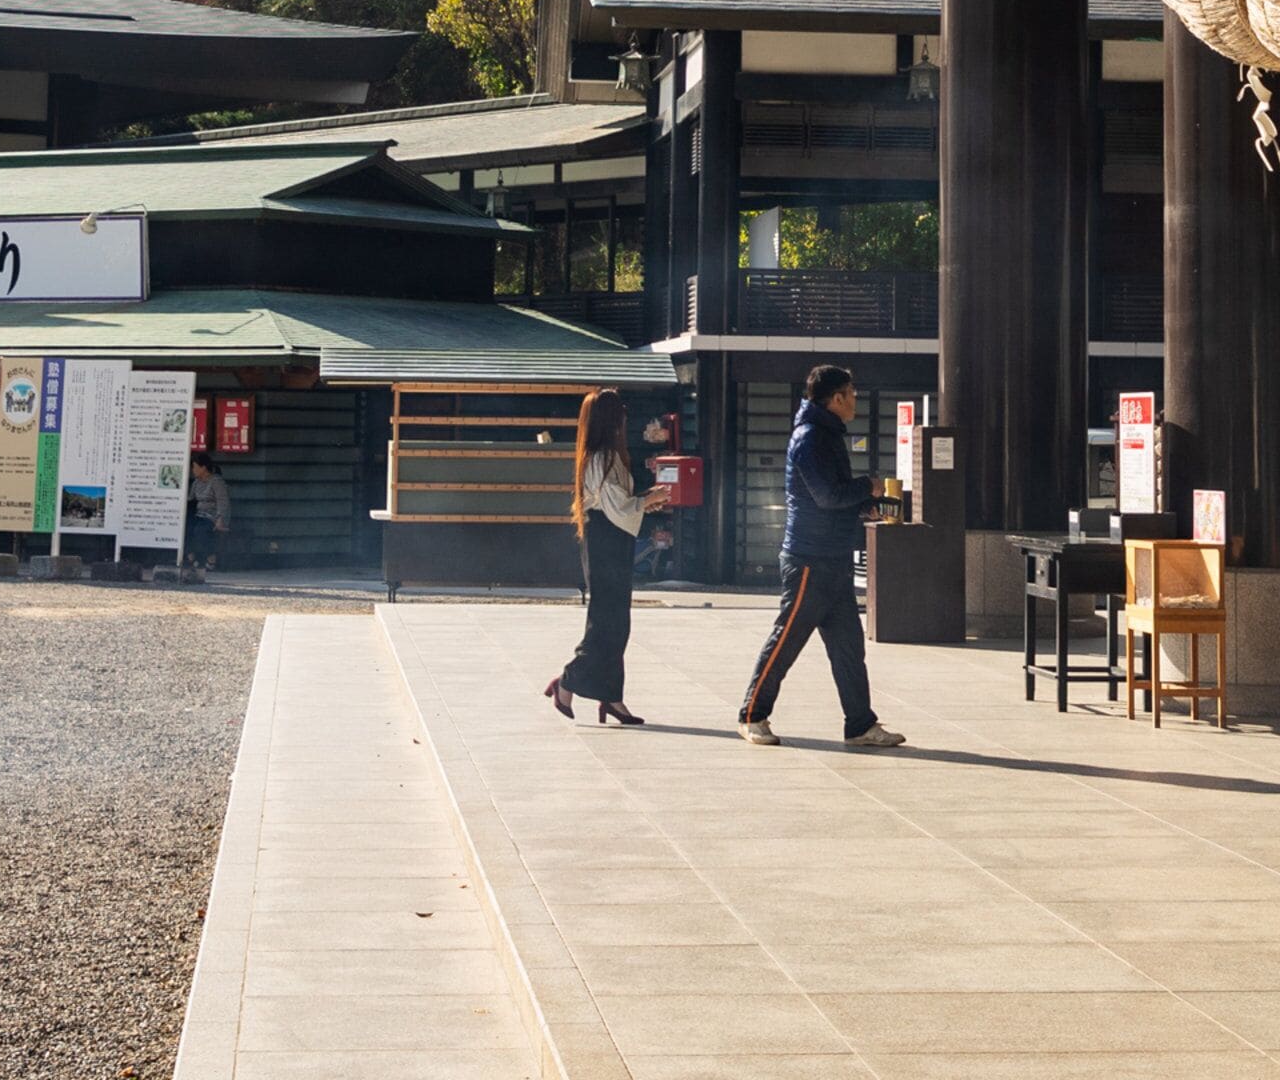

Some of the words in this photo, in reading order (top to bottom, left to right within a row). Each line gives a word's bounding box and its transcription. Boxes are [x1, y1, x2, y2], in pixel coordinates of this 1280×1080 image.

[6, 366, 36, 380] お坊さんに
[44, 361, 60, 430] 塾僧募集
